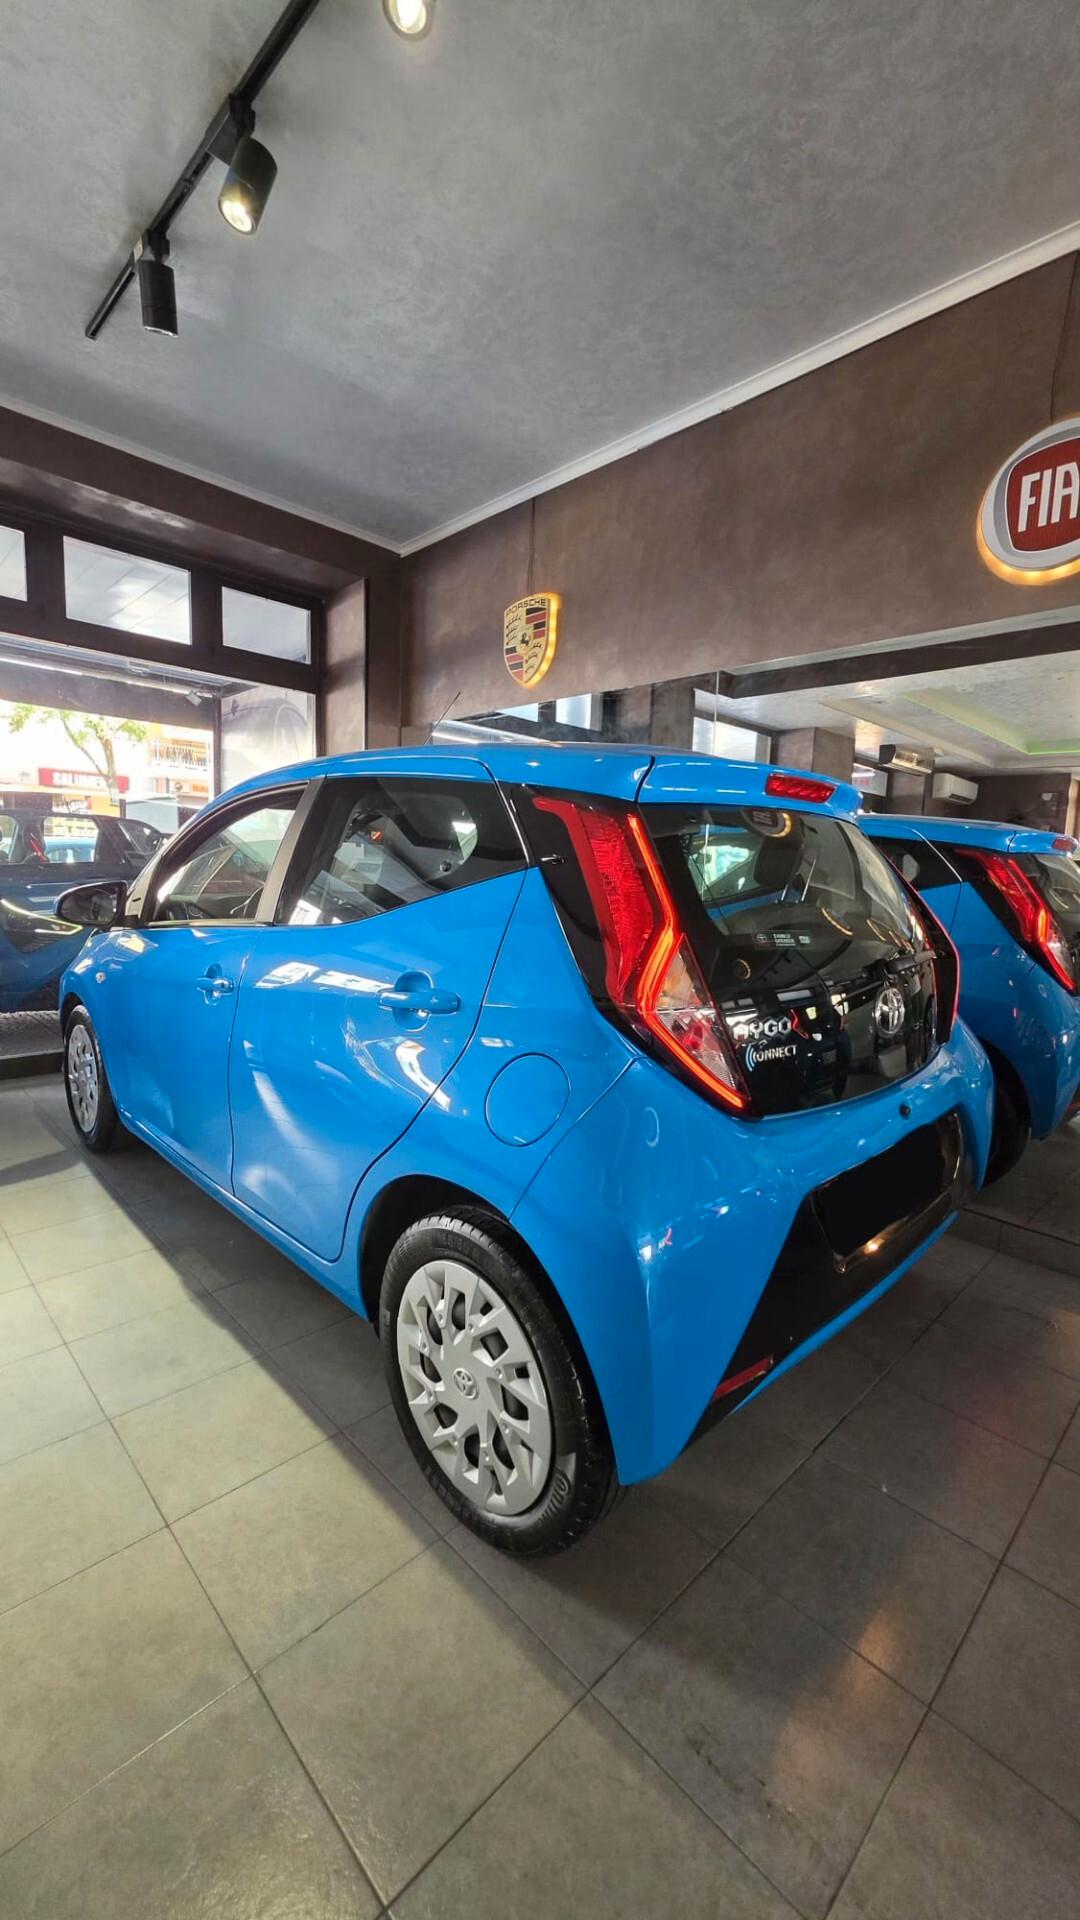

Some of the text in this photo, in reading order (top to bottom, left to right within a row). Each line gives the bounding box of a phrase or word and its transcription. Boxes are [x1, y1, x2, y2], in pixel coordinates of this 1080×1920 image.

[1018, 461, 1079, 532] FIA
[505, 598, 546, 616] PORSCHE
[732, 1017, 792, 1040] AYGO
